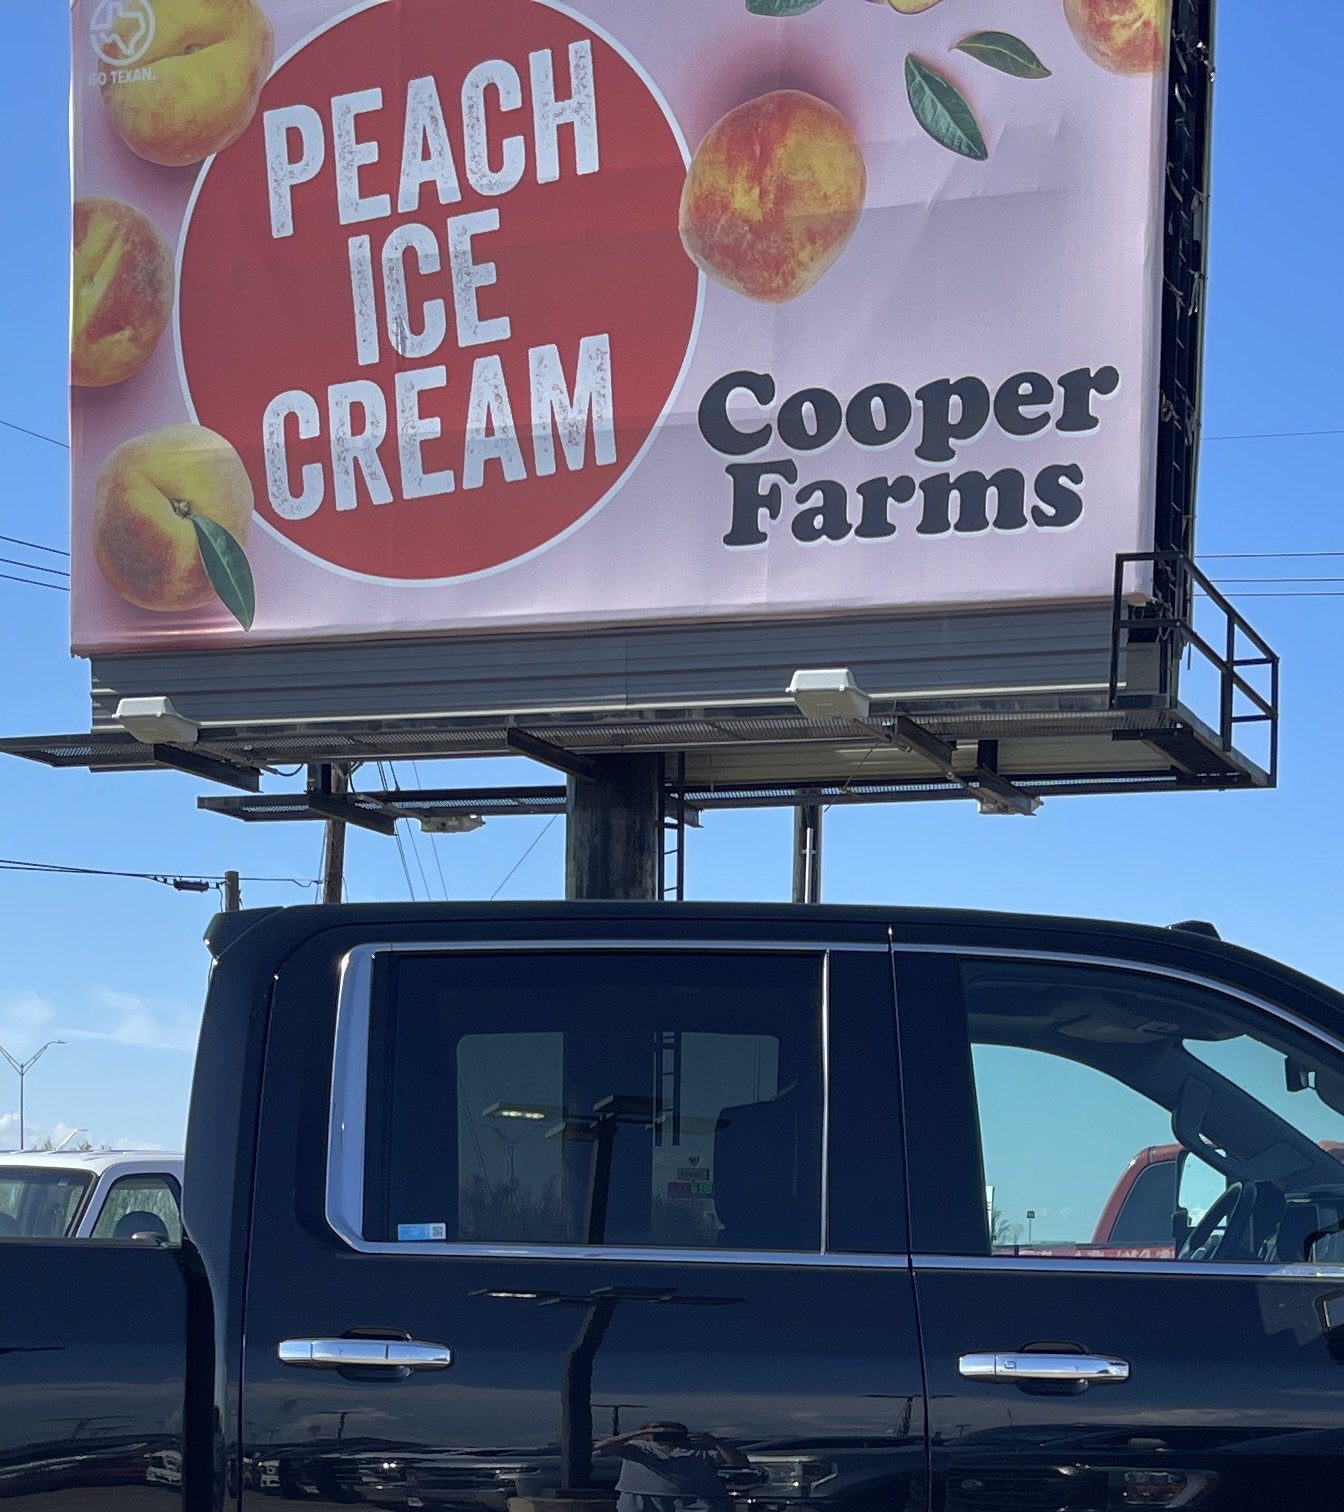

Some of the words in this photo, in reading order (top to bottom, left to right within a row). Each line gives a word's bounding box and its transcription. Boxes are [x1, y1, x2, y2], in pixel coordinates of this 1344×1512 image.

[88, 72, 107, 86] GO
[263, 39, 599, 238] PEACH
[348, 209, 511, 366] ICE
[262, 334, 617, 520] CREAM
[698, 365, 1120, 464] Cooper
[723, 459, 1085, 548] Farms
